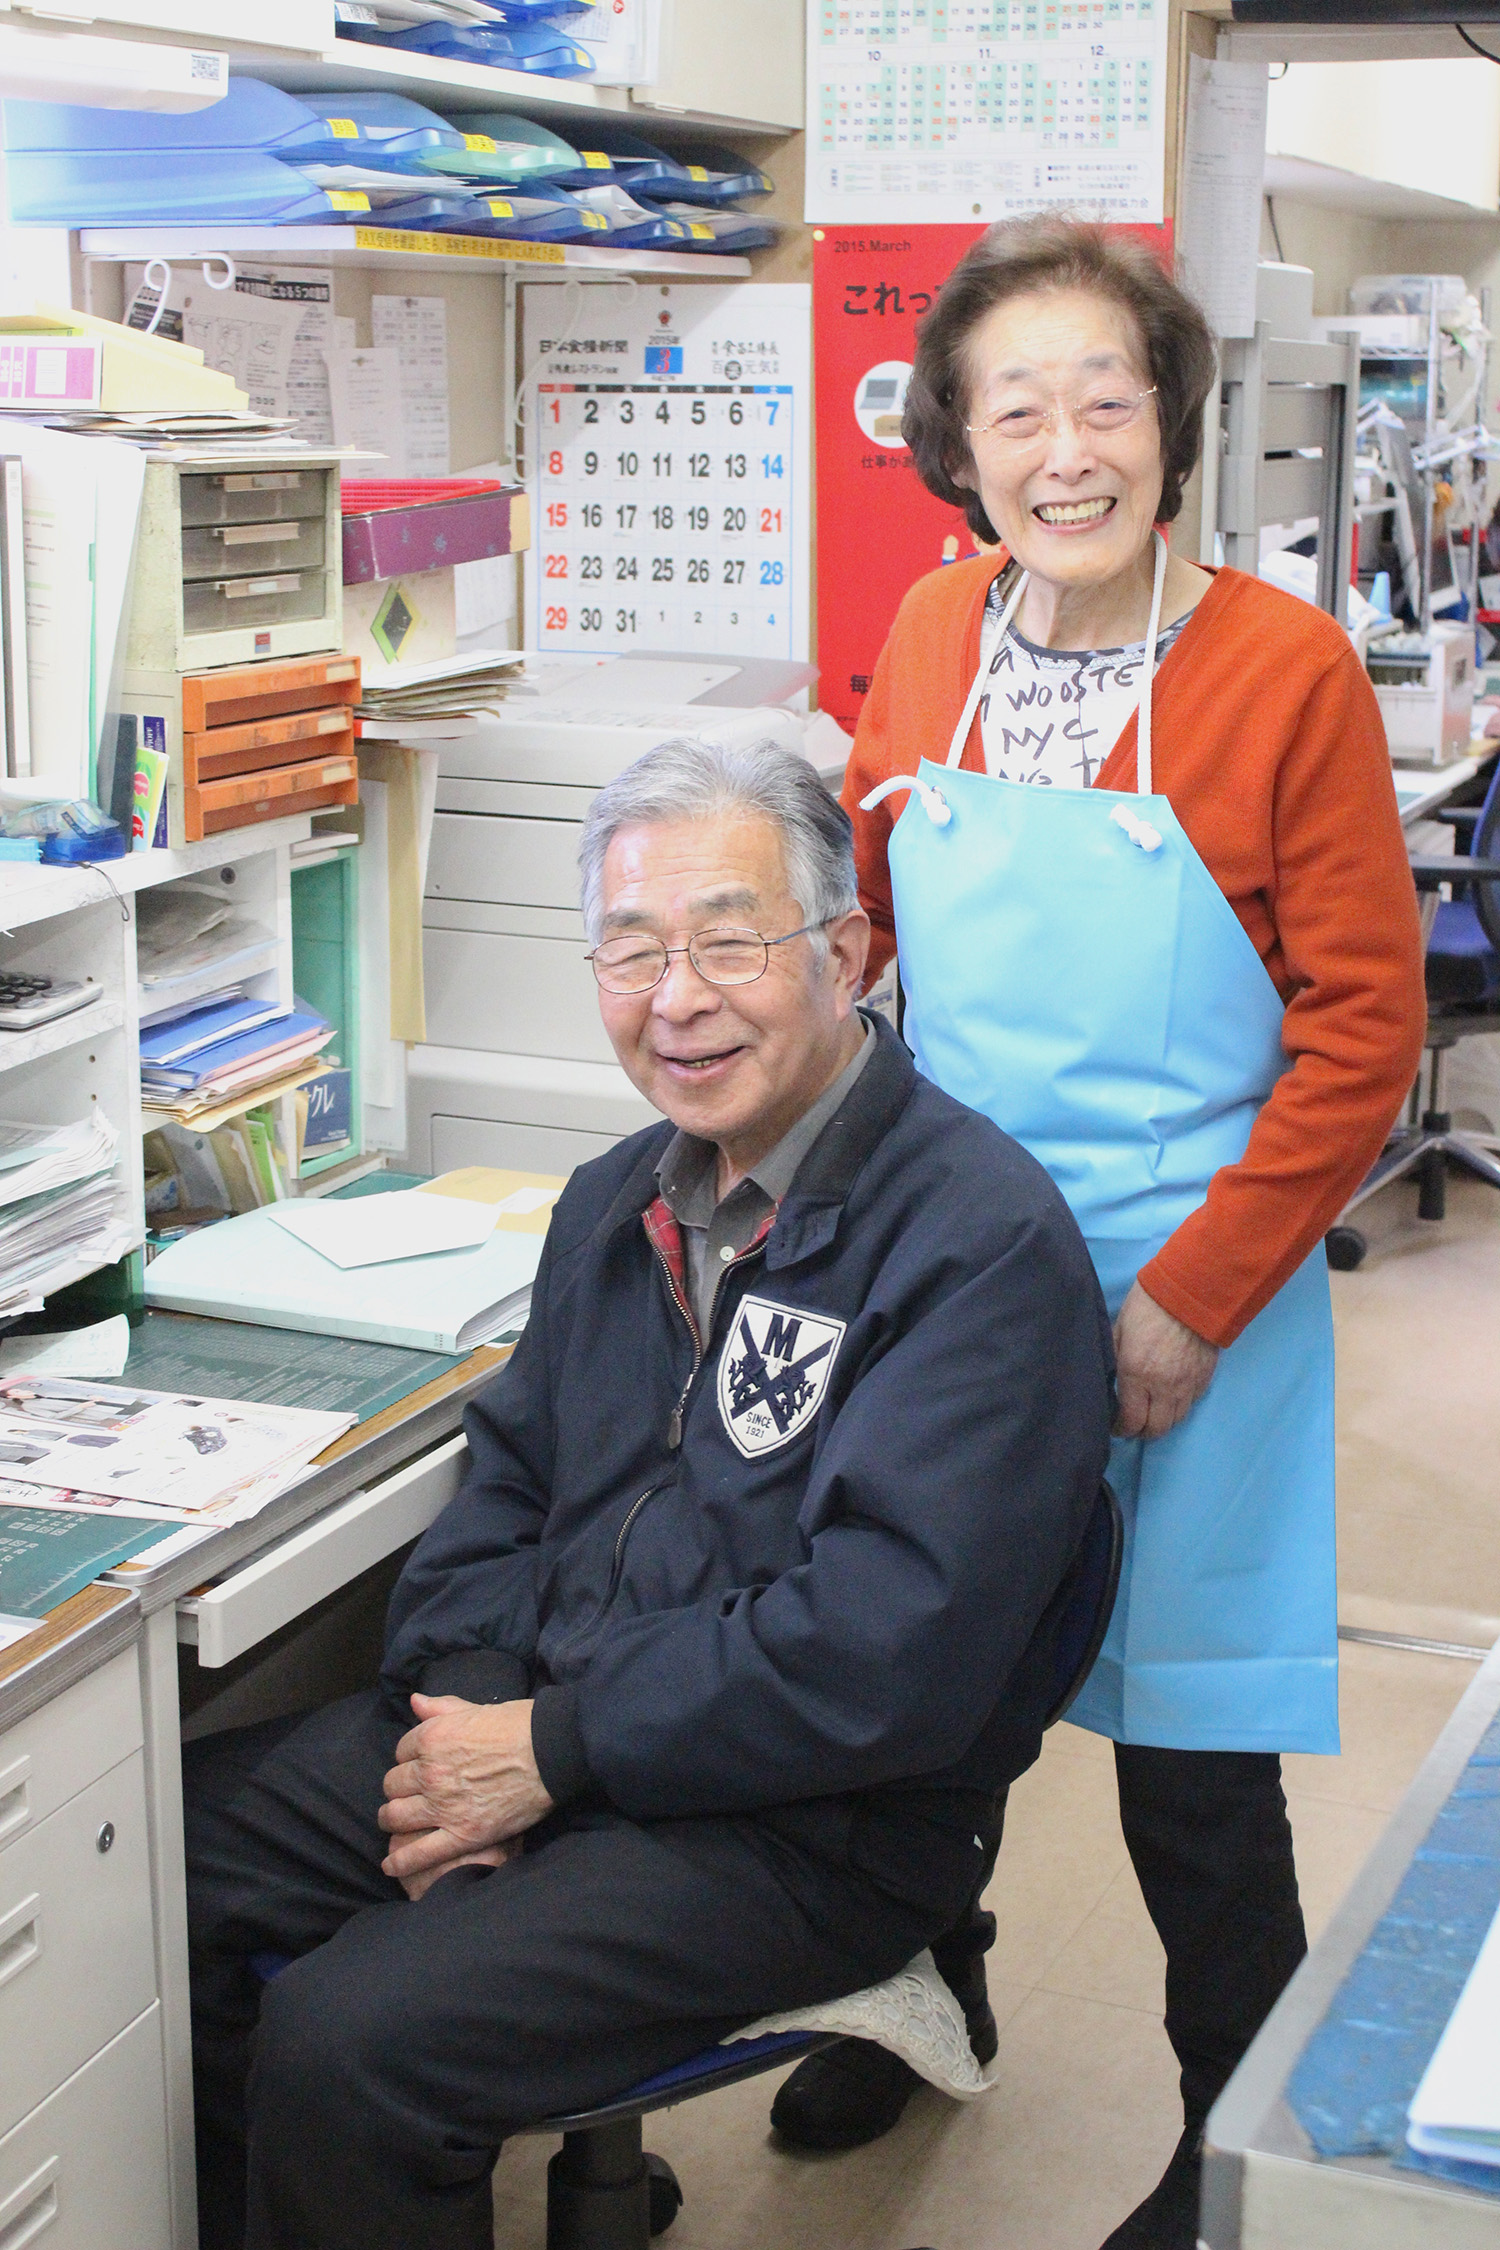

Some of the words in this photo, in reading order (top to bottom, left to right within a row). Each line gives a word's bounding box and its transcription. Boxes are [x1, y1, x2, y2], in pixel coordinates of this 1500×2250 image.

[868, 51, 881, 61] 10
[979, 49, 990, 58] 11
[1091, 45, 1103, 55] 12
[844, 282, 940, 316] これっ
[657, 348, 671, 372] 3
[550, 400, 559, 423] 1
[584, 399, 598, 423] 2
[620, 400, 634, 424] 3
[656, 400, 670, 424] 4
[691, 400, 706, 425] 5
[729, 401, 743, 425] 6
[766, 401, 779, 425] 7
[549, 451, 563, 475] 8
[585, 451, 598, 475] 9
[618, 452, 638, 476] 10
[653, 453, 671, 476] 11
[689, 453, 709, 477] 12
[725, 454, 746, 478] 13
[762, 454, 783, 478] 14
[547, 504, 567, 527] 15
[582, 504, 602, 527] 16
[617, 505, 637, 528] 17
[653, 505, 673, 529] 18
[688, 506, 709, 530] 19
[724, 507, 745, 531] 20
[761, 508, 781, 532] 21
[546, 555, 567, 578] 22
[581, 556, 602, 579] 23
[617, 557, 638, 580] 24
[652, 558, 673, 581] 25
[688, 559, 709, 583] 26
[724, 560, 745, 584] 27
[760, 561, 783, 585] 28
[546, 607, 567, 630] 29
[580, 608, 602, 631] 30
[616, 609, 635, 632] 31
[659, 610, 664, 622] 1
[694, 611, 702, 623] 2
[731, 612, 738, 625] 3
[768, 614, 775, 625] 4
[850, 675, 873, 695] 毎
[761, 1313, 803, 1362] M
[745, 1426, 765, 1438] 1921
[746, 1412, 773, 1429] SINCE
